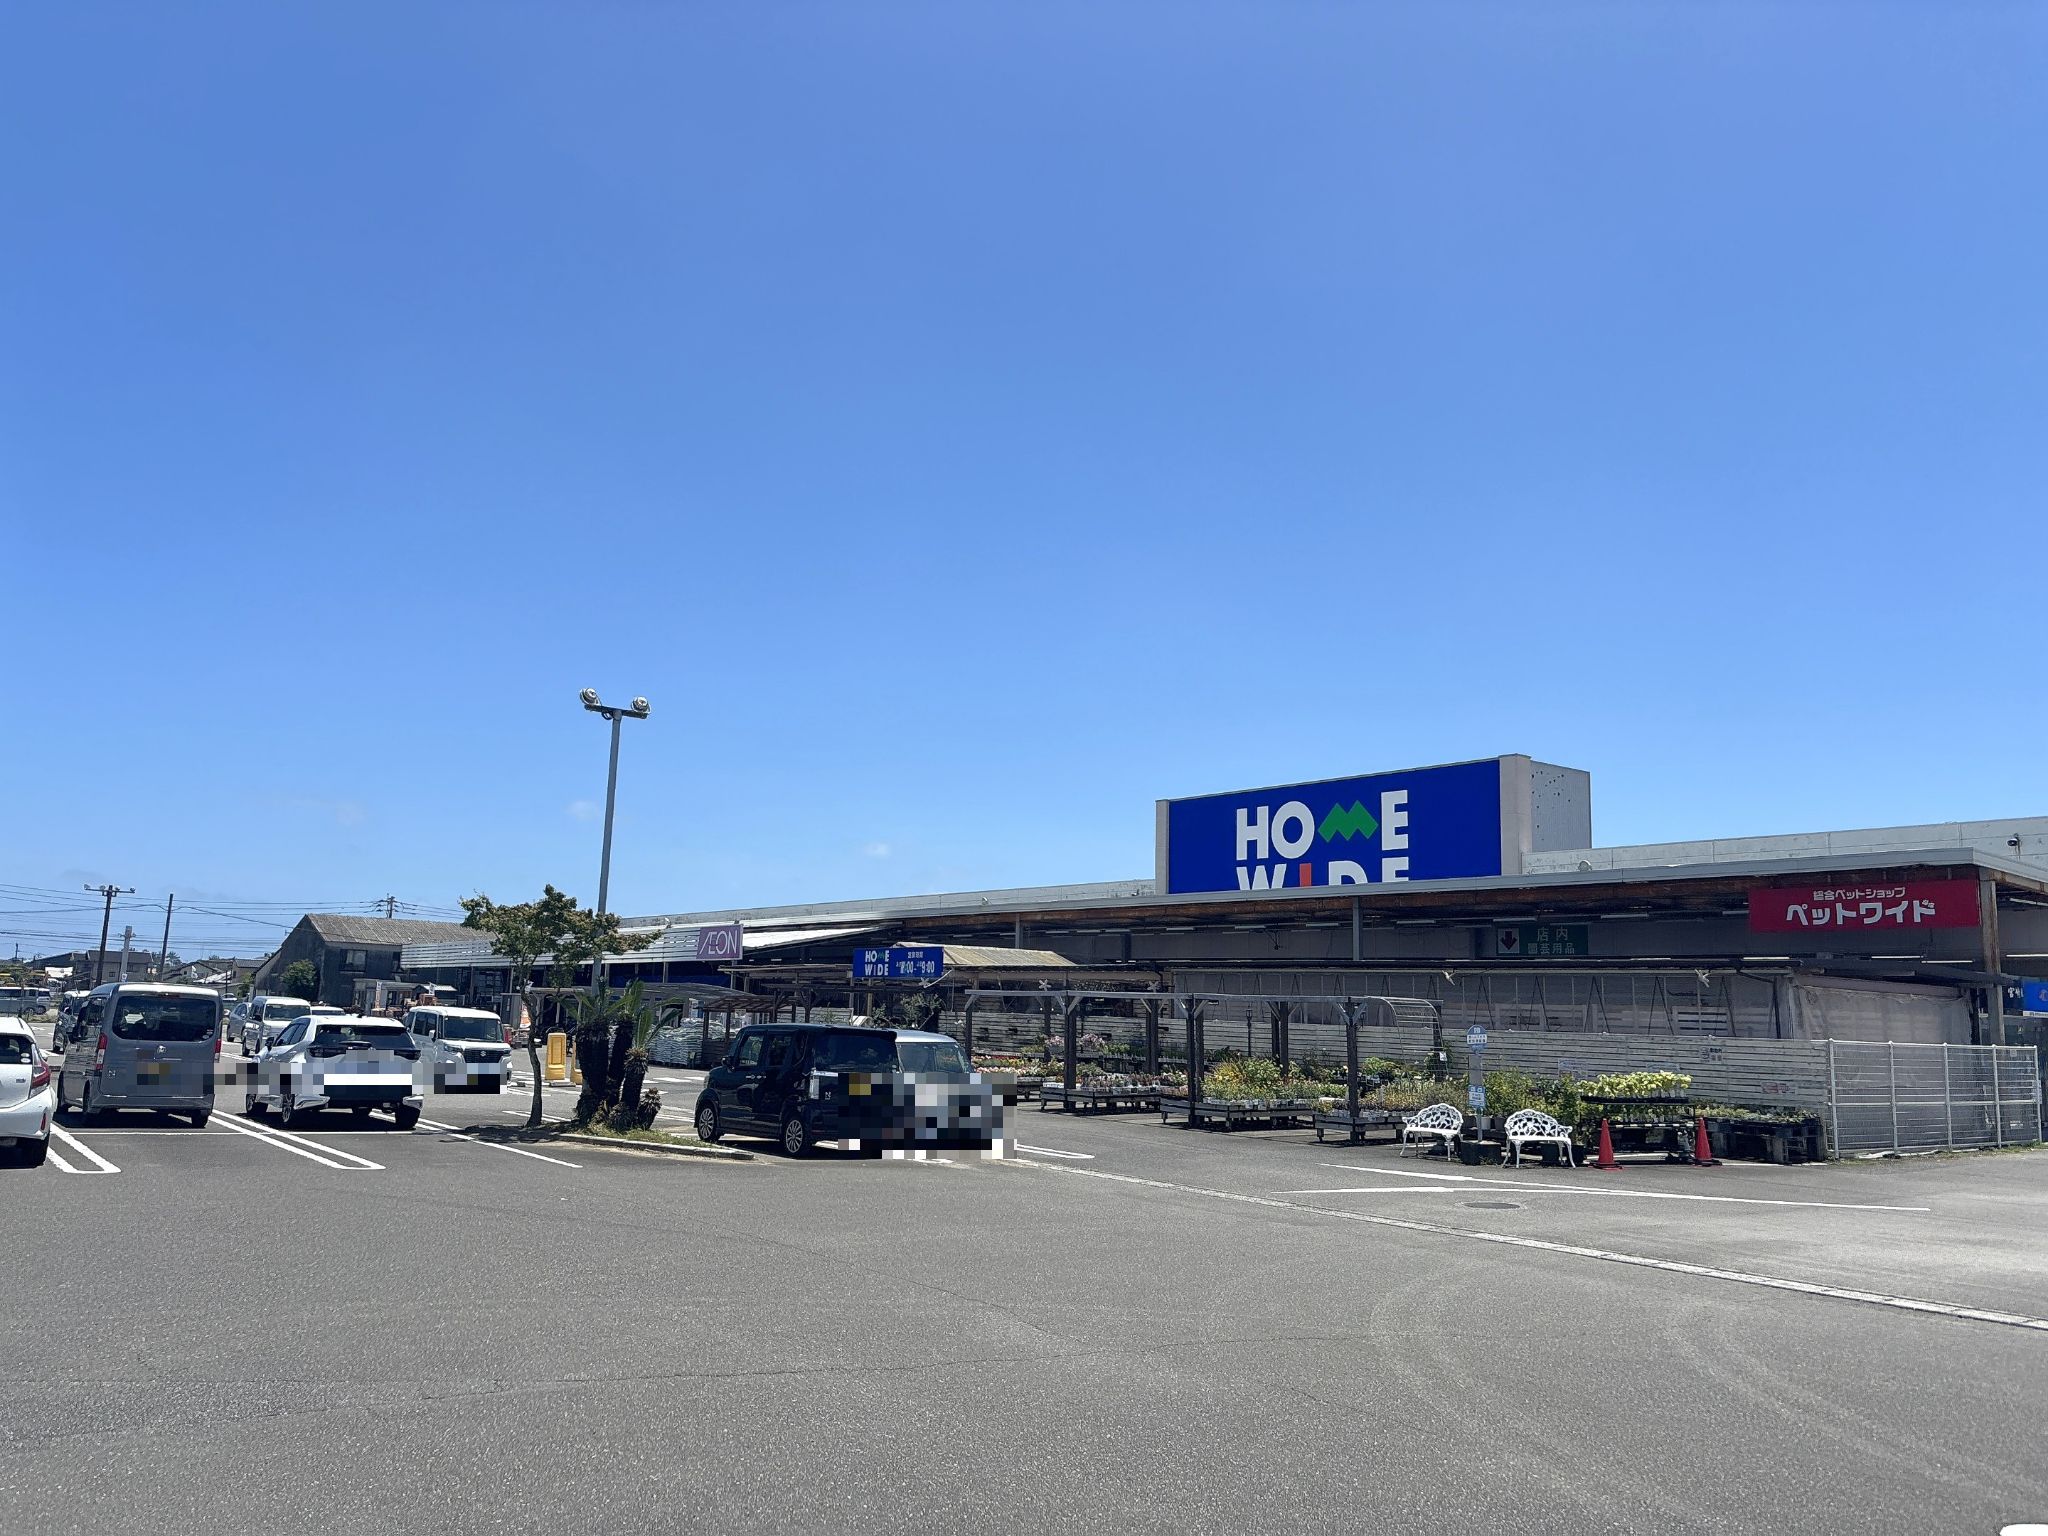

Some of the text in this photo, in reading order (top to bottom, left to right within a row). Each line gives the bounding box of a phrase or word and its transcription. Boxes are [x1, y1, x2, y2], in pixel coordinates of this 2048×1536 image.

[1236, 790, 1409, 860] HOME
[1786, 900, 1936, 926] ペットワイド
[865, 964, 889, 976] WIDE
